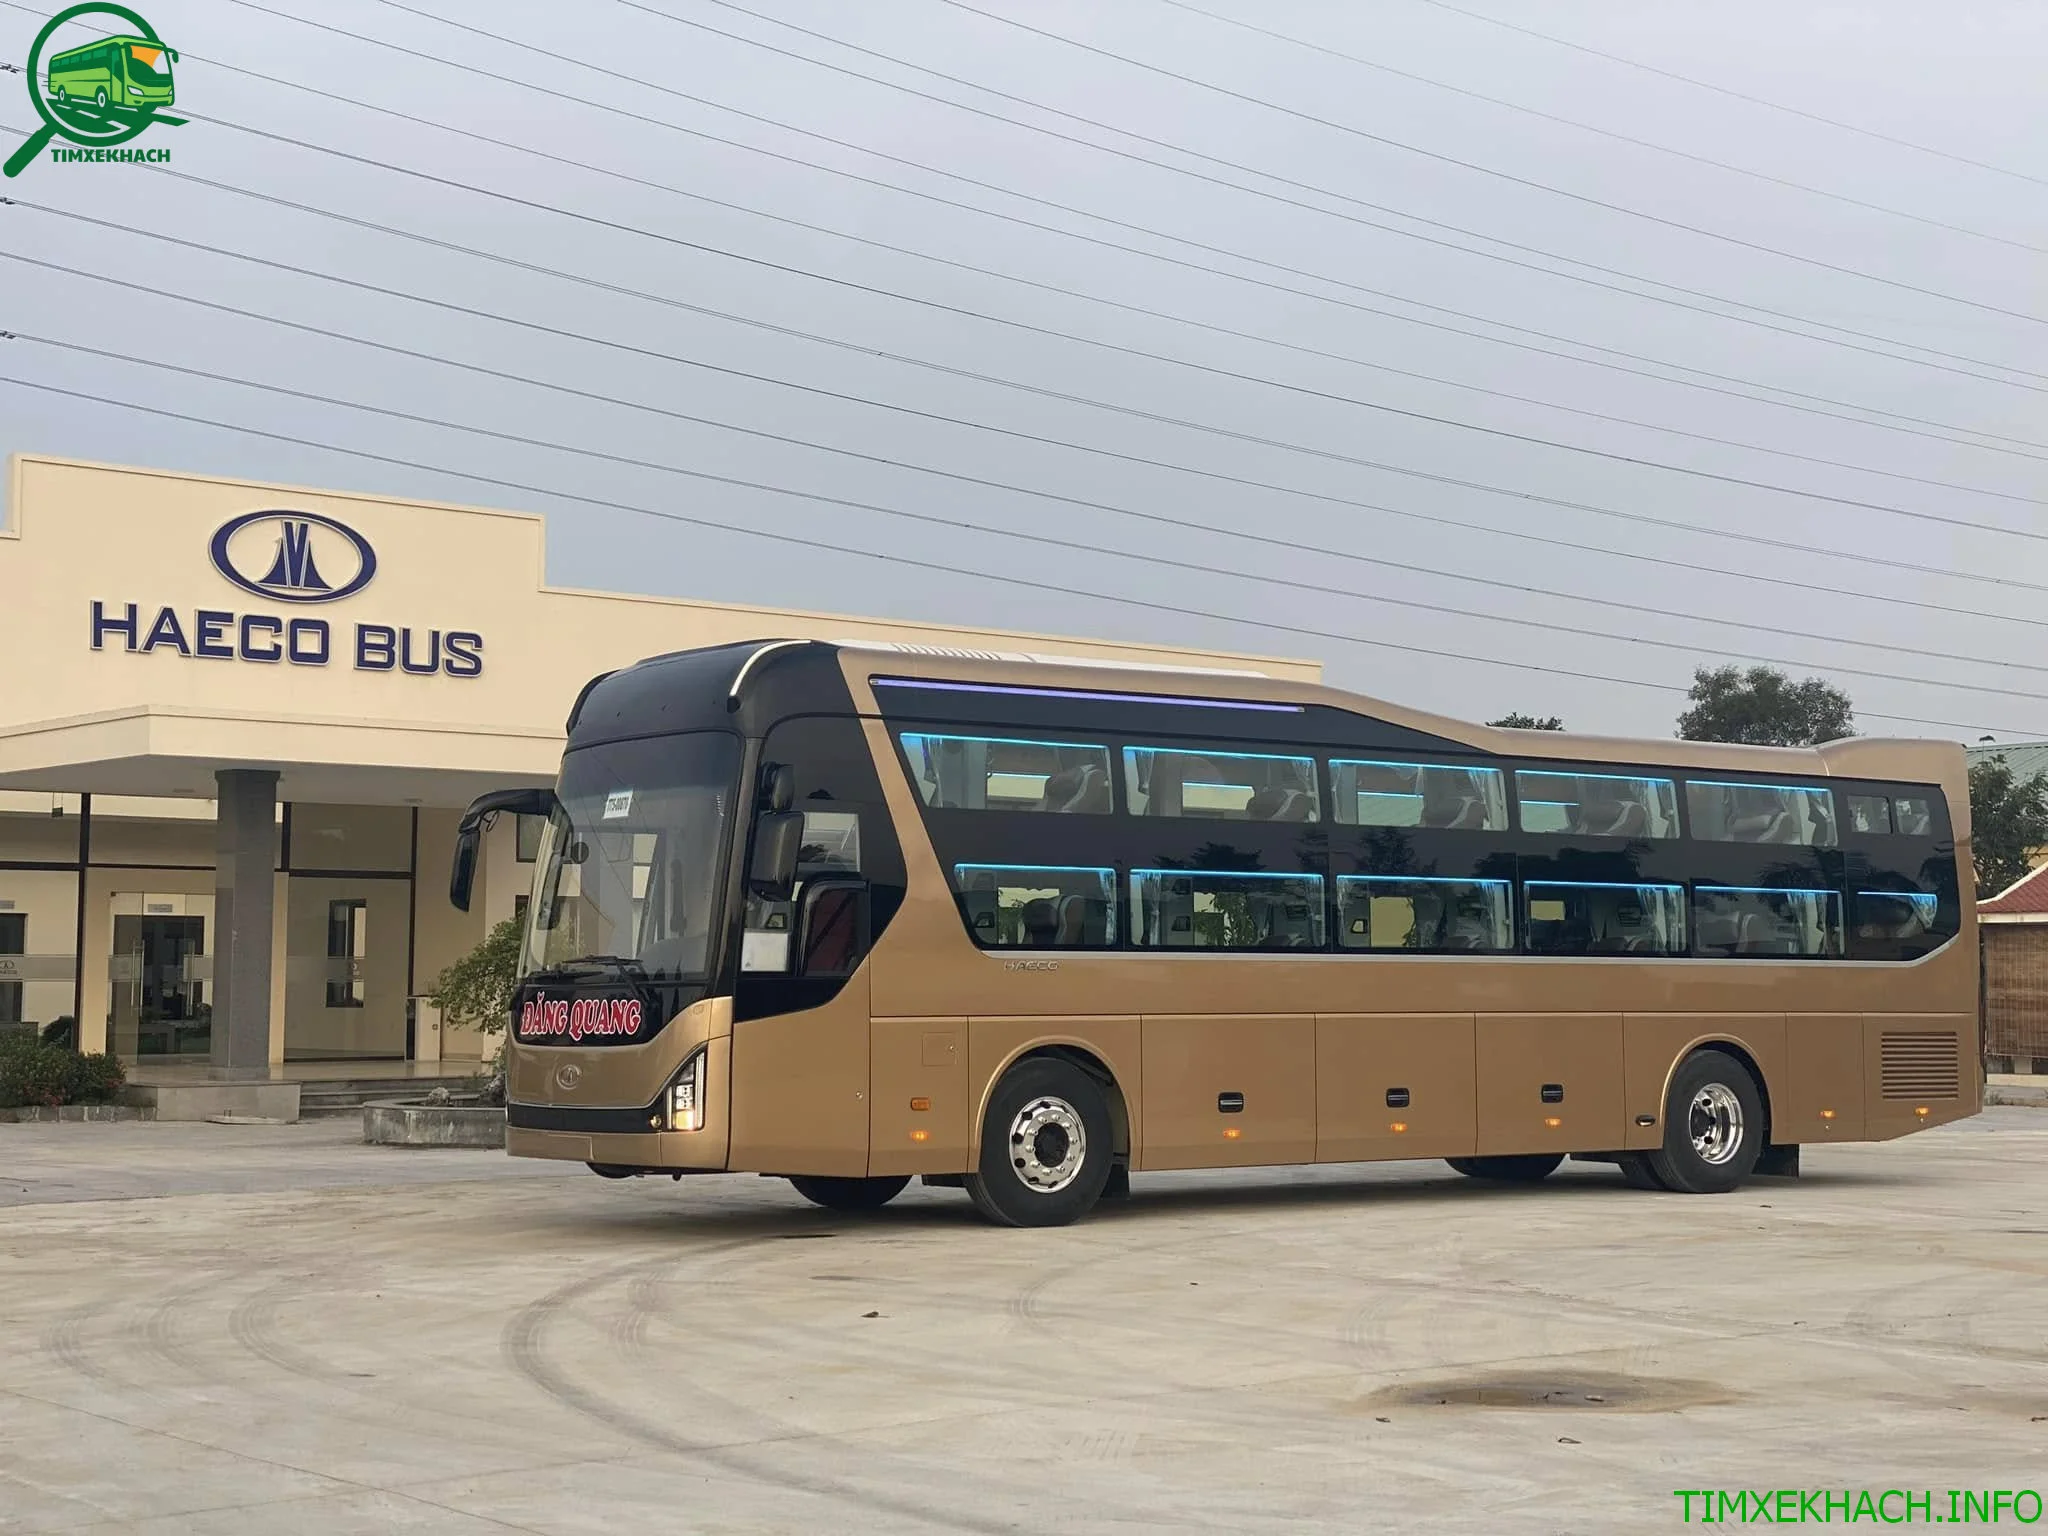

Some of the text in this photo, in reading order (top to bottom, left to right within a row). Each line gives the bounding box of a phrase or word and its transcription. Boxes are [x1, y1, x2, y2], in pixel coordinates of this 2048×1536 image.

[91, 600, 483, 677] HAECO BUS
[520, 991, 641, 1041] ĐĂNG QUANG
